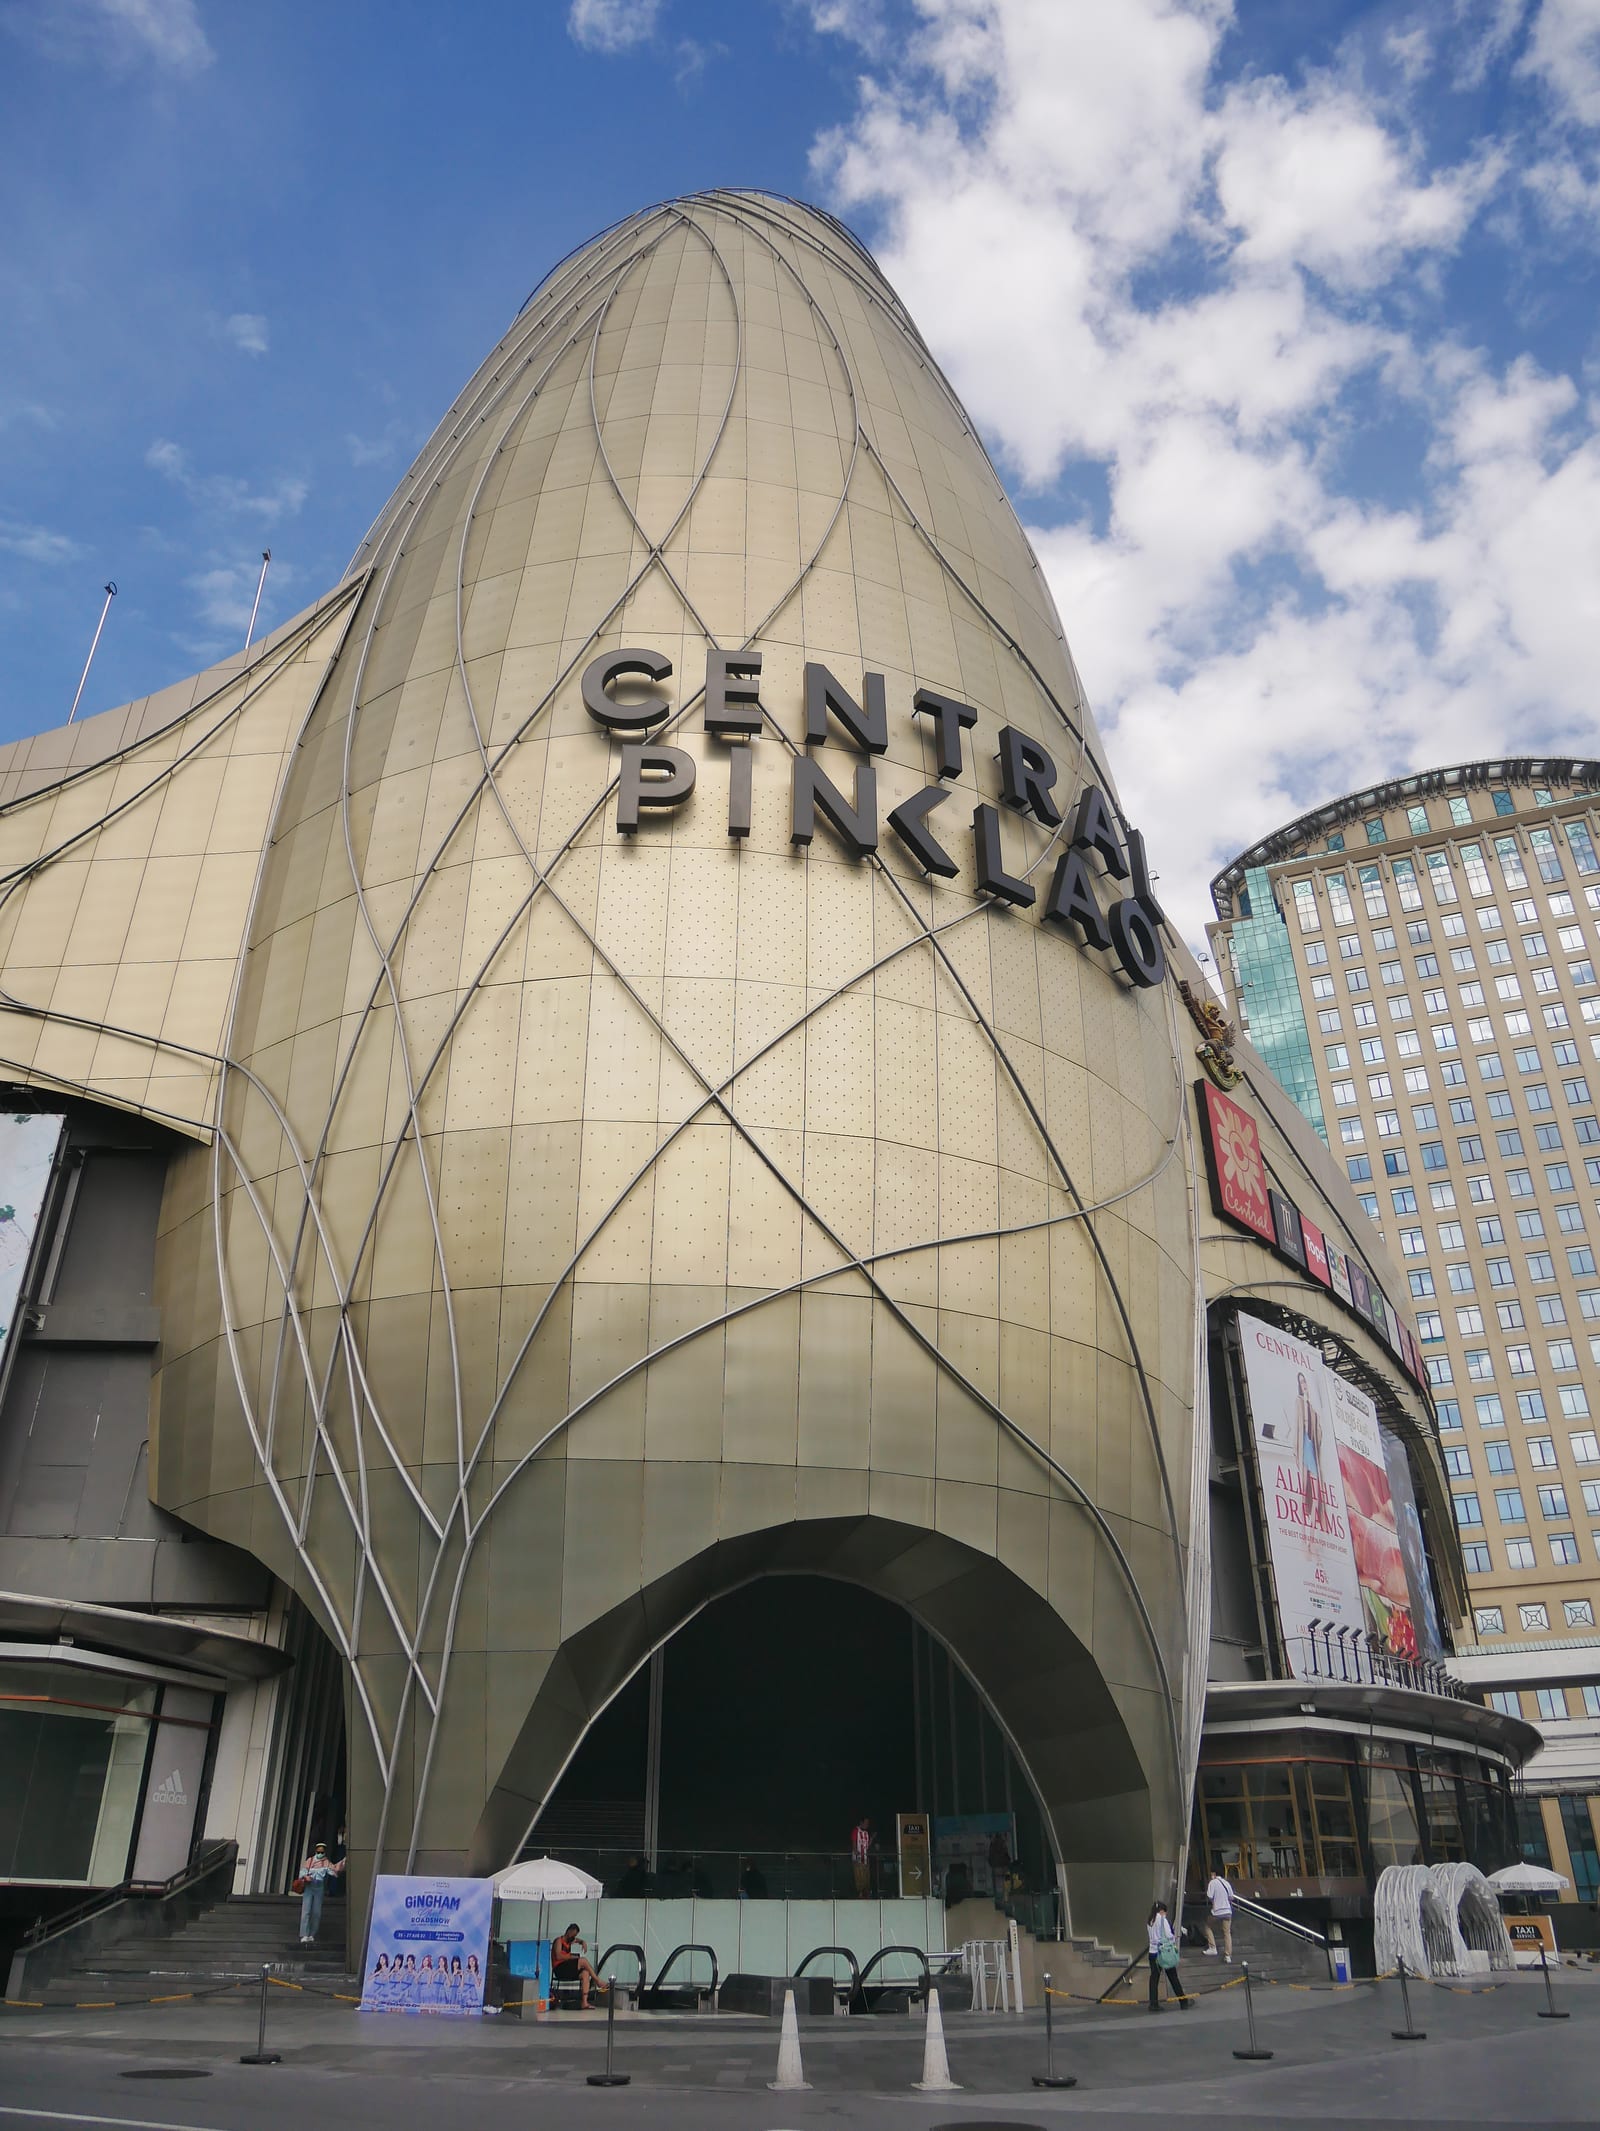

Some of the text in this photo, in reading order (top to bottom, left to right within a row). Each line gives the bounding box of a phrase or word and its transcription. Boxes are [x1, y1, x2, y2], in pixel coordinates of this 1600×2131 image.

[581, 648, 1165, 926] CENTRAL
[616, 744, 1166, 988] PINKLAO
[1225, 1183, 1270, 1234] Central
[1304, 1232, 1327, 1265] Tops
[1256, 1332, 1315, 1372] CENTRAL
[1275, 1465, 1339, 1509] ALL THE
[1275, 1494, 1345, 1540] DREAMS
[153, 1791, 187, 1805] adidas
[1515, 1926, 1535, 1934] TAXI
